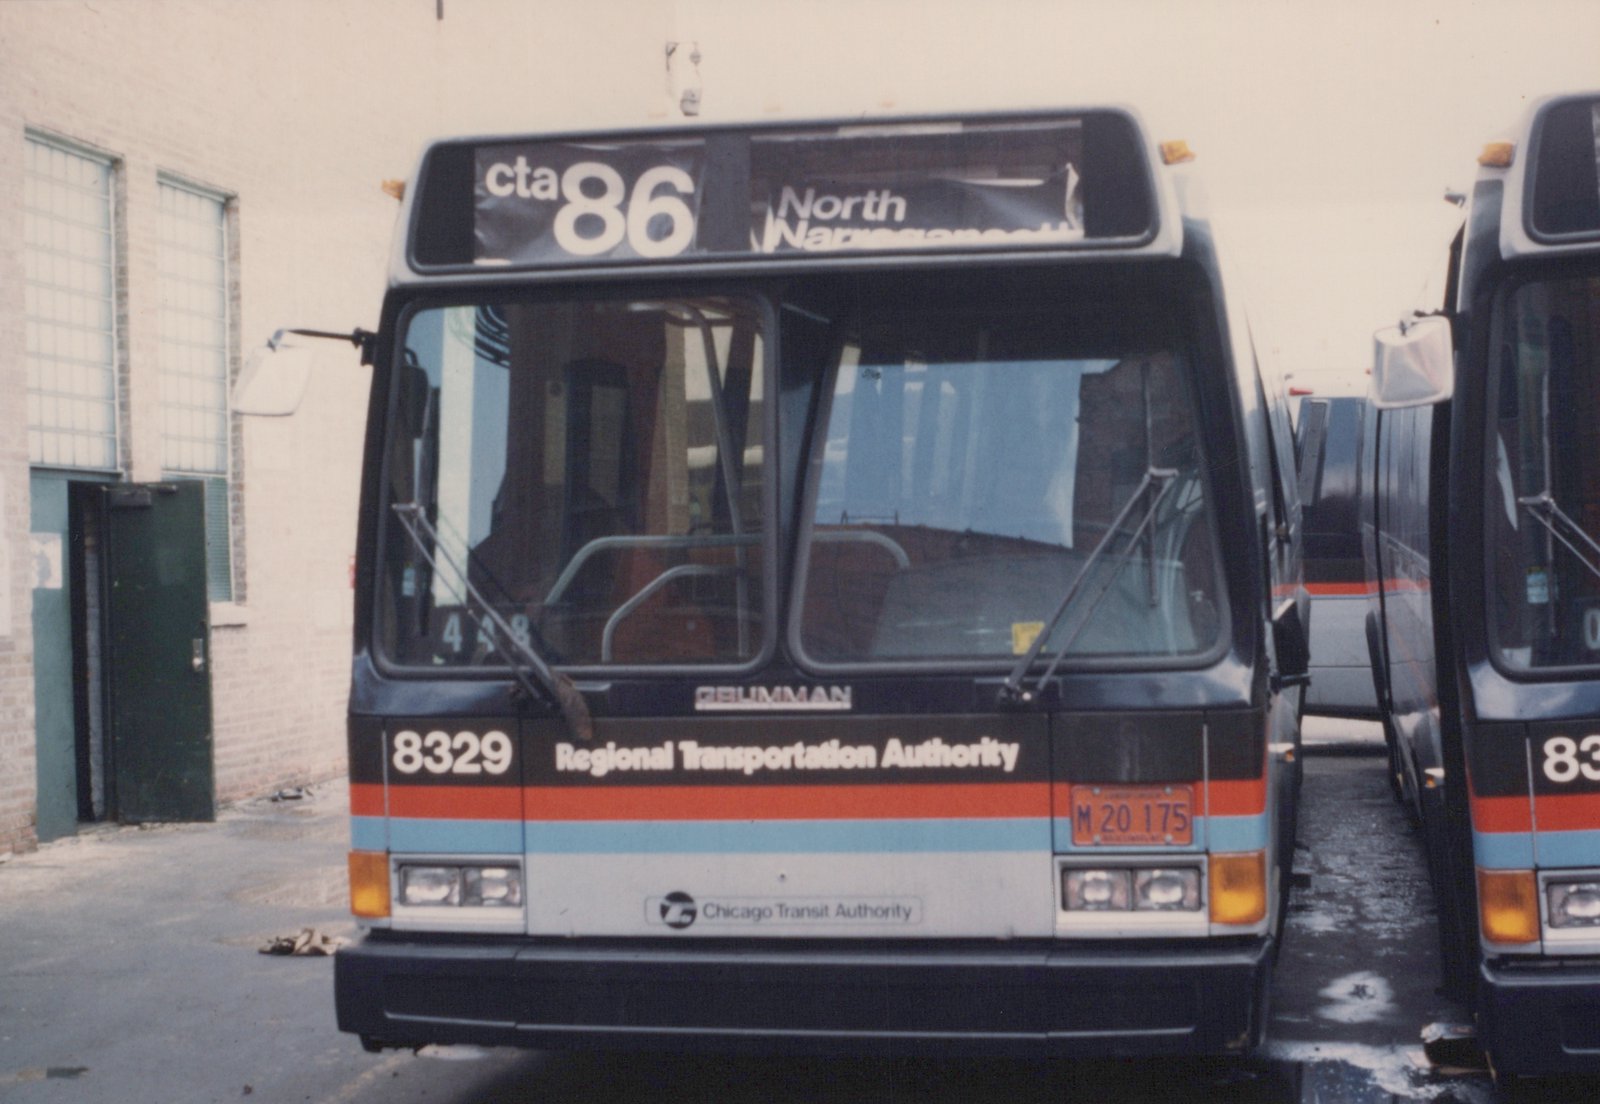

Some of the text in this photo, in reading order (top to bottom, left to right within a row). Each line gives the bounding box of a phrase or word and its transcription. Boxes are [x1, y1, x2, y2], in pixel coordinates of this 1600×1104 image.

[486, 156, 695, 258] cta 86
[777, 186, 906, 222] North
[695, 685, 852, 704] GRUMMAN
[392, 730, 513, 775] 8329
[555, 737, 1020, 776] Regional Transportation Authority
[1077, 802, 1188, 833] M 20 175
[703, 902, 913, 922] Chicago Transit Authority
